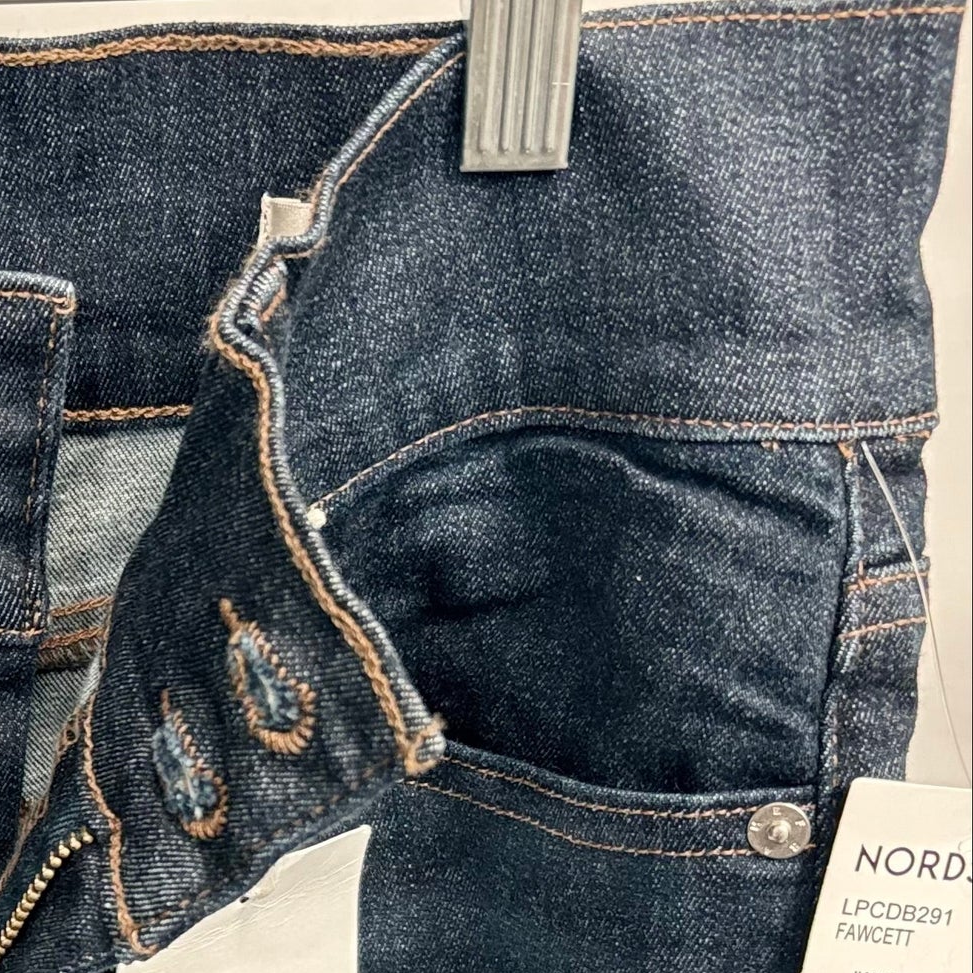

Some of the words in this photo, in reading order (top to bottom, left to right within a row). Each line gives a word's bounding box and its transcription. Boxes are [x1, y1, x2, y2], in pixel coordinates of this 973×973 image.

[855, 844, 972, 883] NORD
[842, 898, 953, 926] LPCDB291
[835, 922, 915, 947] FAWCETT
